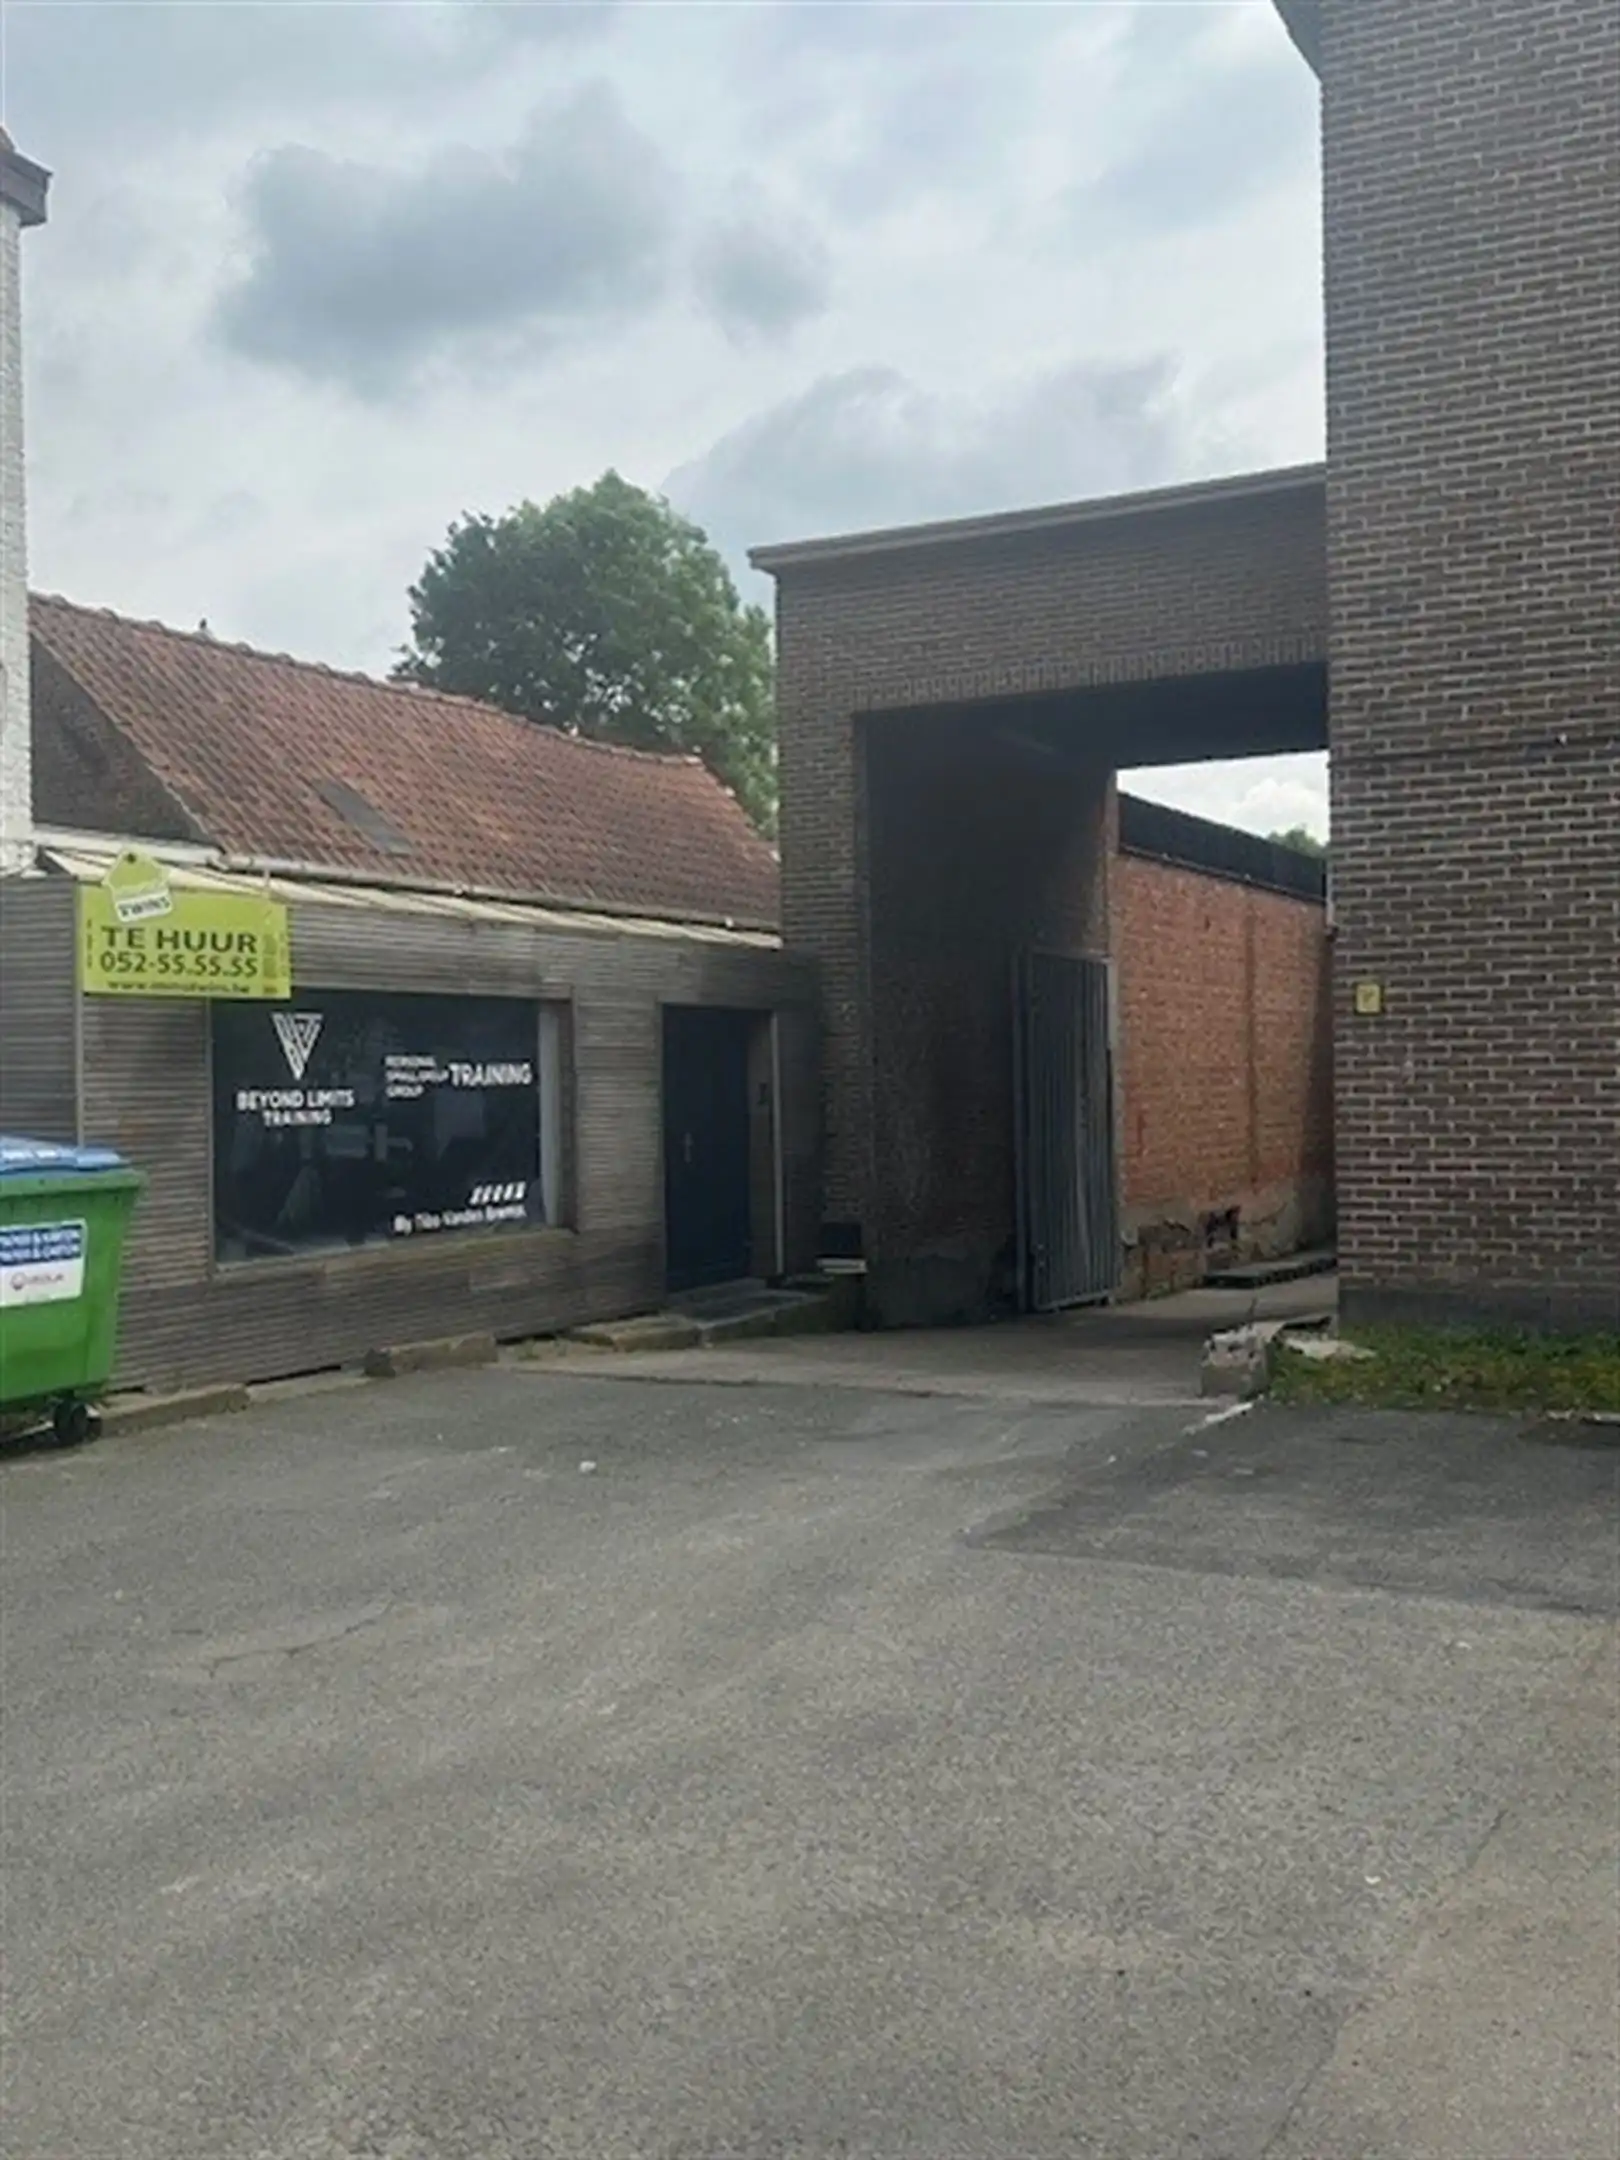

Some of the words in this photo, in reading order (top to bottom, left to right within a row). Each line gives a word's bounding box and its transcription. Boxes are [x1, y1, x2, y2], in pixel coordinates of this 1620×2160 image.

[101, 926, 146, 949] TE
[156, 929, 258, 954] HUUR
[100, 950, 258, 978] 052-55.55.55
[449, 1062, 532, 1087] TRAINING
[237, 1090, 305, 1110] BEYOND
[307, 1089, 355, 1108] LIMITS
[263, 1109, 332, 1127] TRAINING
